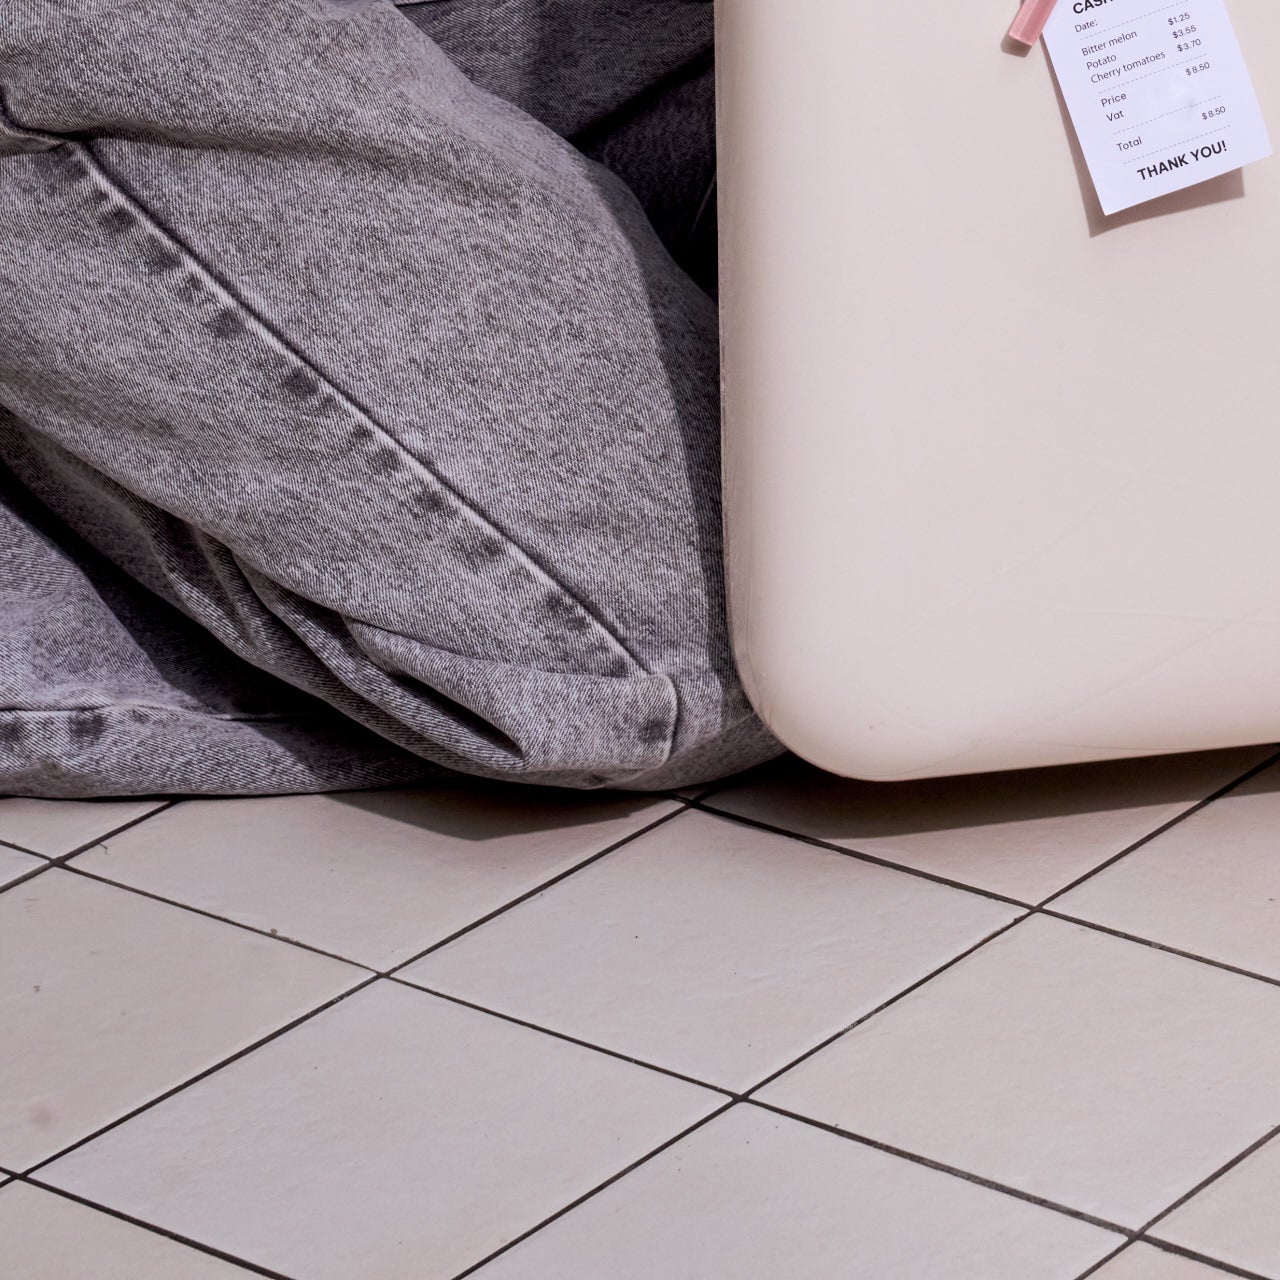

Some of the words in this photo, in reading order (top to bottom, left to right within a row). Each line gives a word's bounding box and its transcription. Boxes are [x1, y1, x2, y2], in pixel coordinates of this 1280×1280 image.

[1074, 19, 1098, 33] Date:
[1081, 41, 1107, 56] Bitter
[1108, 30, 1138, 47] melon
[1168, 12, 1190, 26] $1.25
[1086, 54, 1117, 70] Potato
[1172, 25, 1197, 39] $3.55
[1091, 68, 1121, 83] Cherry
[1123, 51, 1166, 72] tomatoes
[1101, 91, 1127, 107] Price
[1105, 110, 1124, 122] Vat
[1116, 136, 1142, 152] Total
[1137, 154, 1189, 181] THANK
[1189, 140, 1227, 164] YOU!
